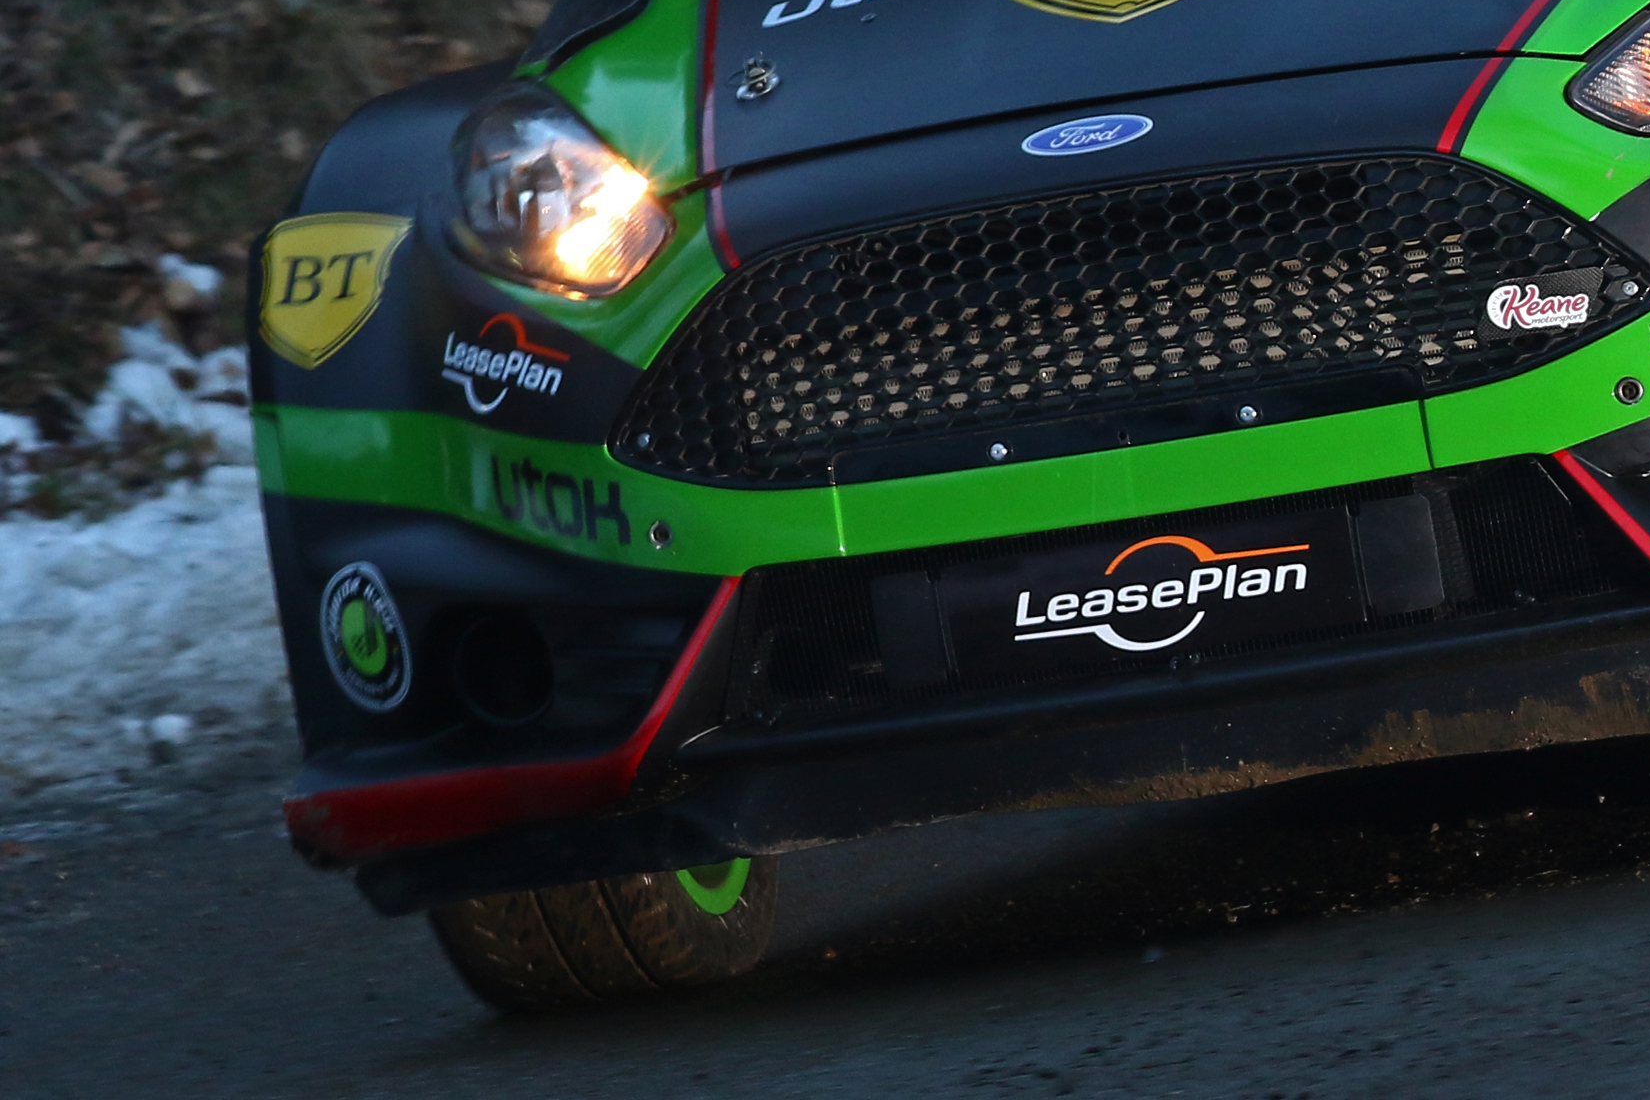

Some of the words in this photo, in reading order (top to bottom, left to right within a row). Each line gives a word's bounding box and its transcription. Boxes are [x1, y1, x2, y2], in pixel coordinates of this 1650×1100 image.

[1050, 123, 1123, 148] Ford
[279, 250, 375, 307] BT
[1502, 286, 1586, 327] Keane
[1530, 312, 1584, 326] motorsport
[444, 331, 564, 396] LeasePlan
[1016, 560, 1308, 627] LeasePlan
